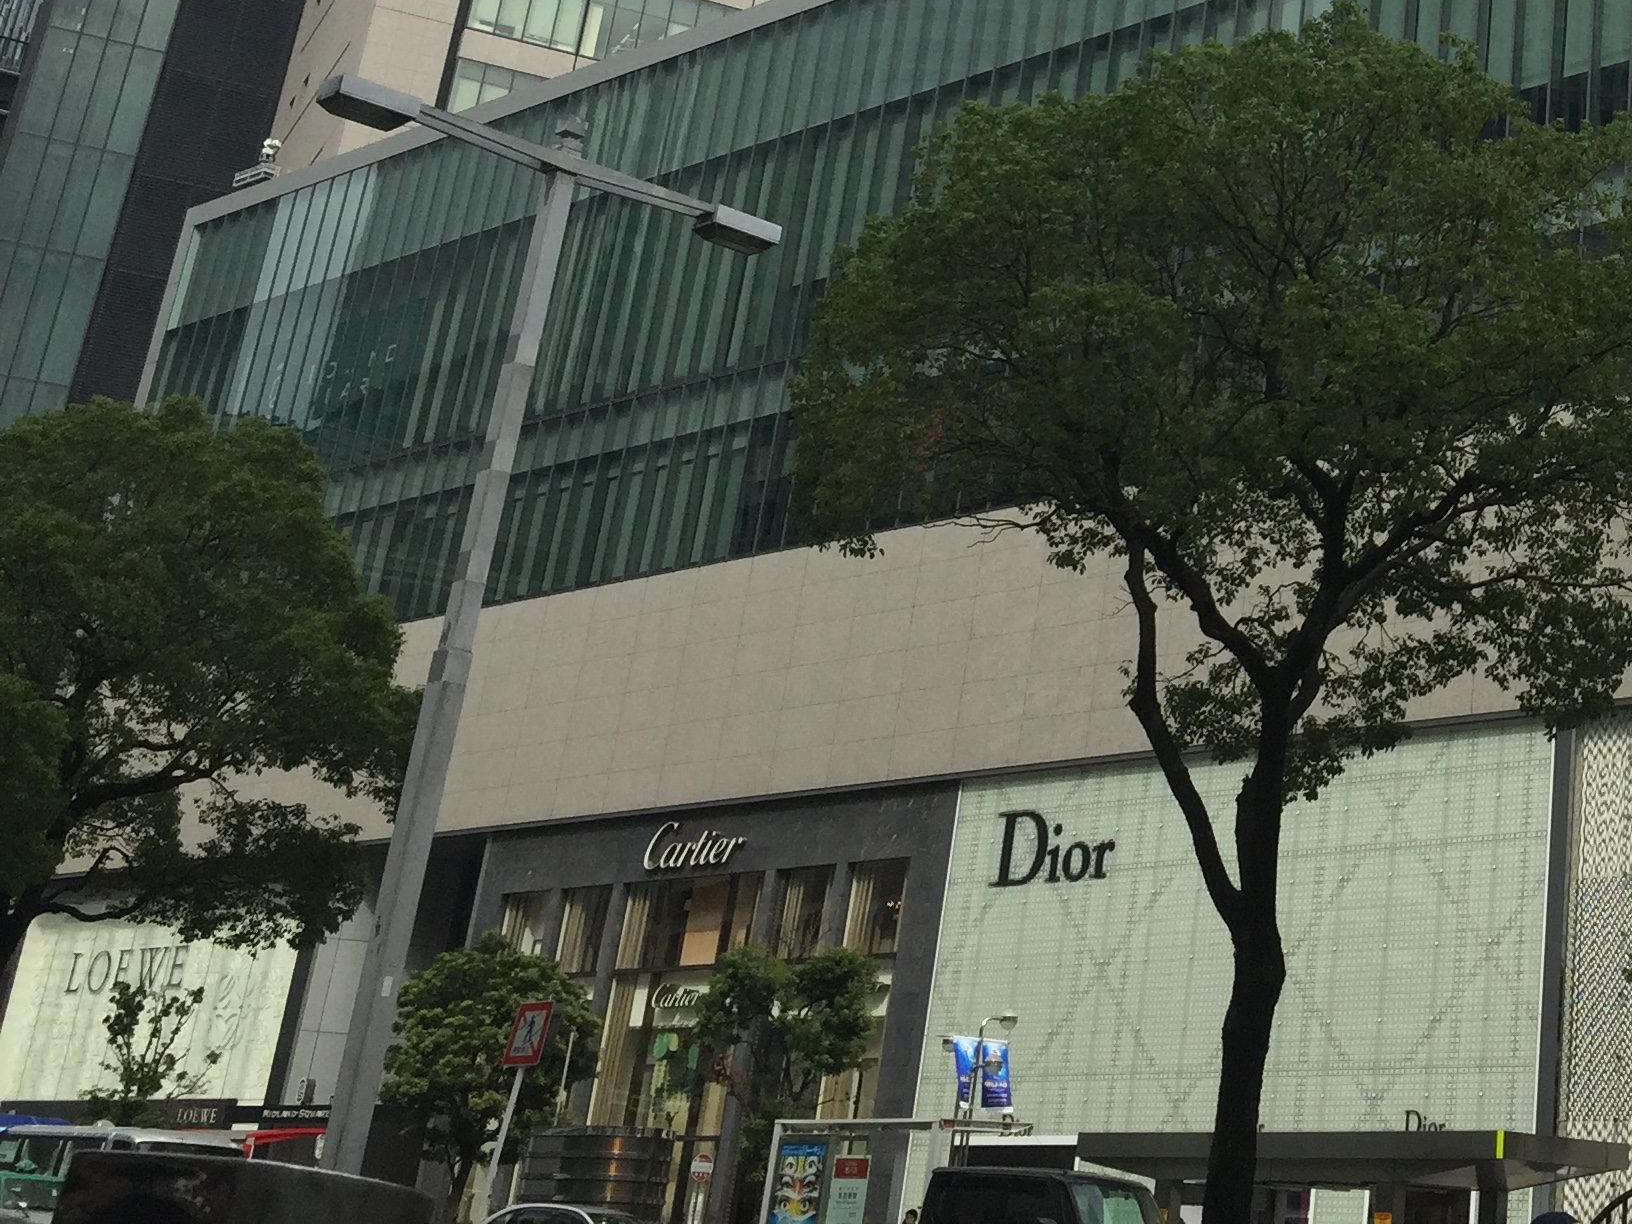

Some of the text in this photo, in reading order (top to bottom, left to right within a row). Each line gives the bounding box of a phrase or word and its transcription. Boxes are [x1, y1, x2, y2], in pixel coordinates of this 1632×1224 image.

[643, 821, 747, 870] Cartier
[988, 809, 1116, 887] Dior
[64, 944, 190, 994] LOEWE
[651, 983, 703, 1009] Cartier
[176, 1107, 218, 1124] LOEWE
